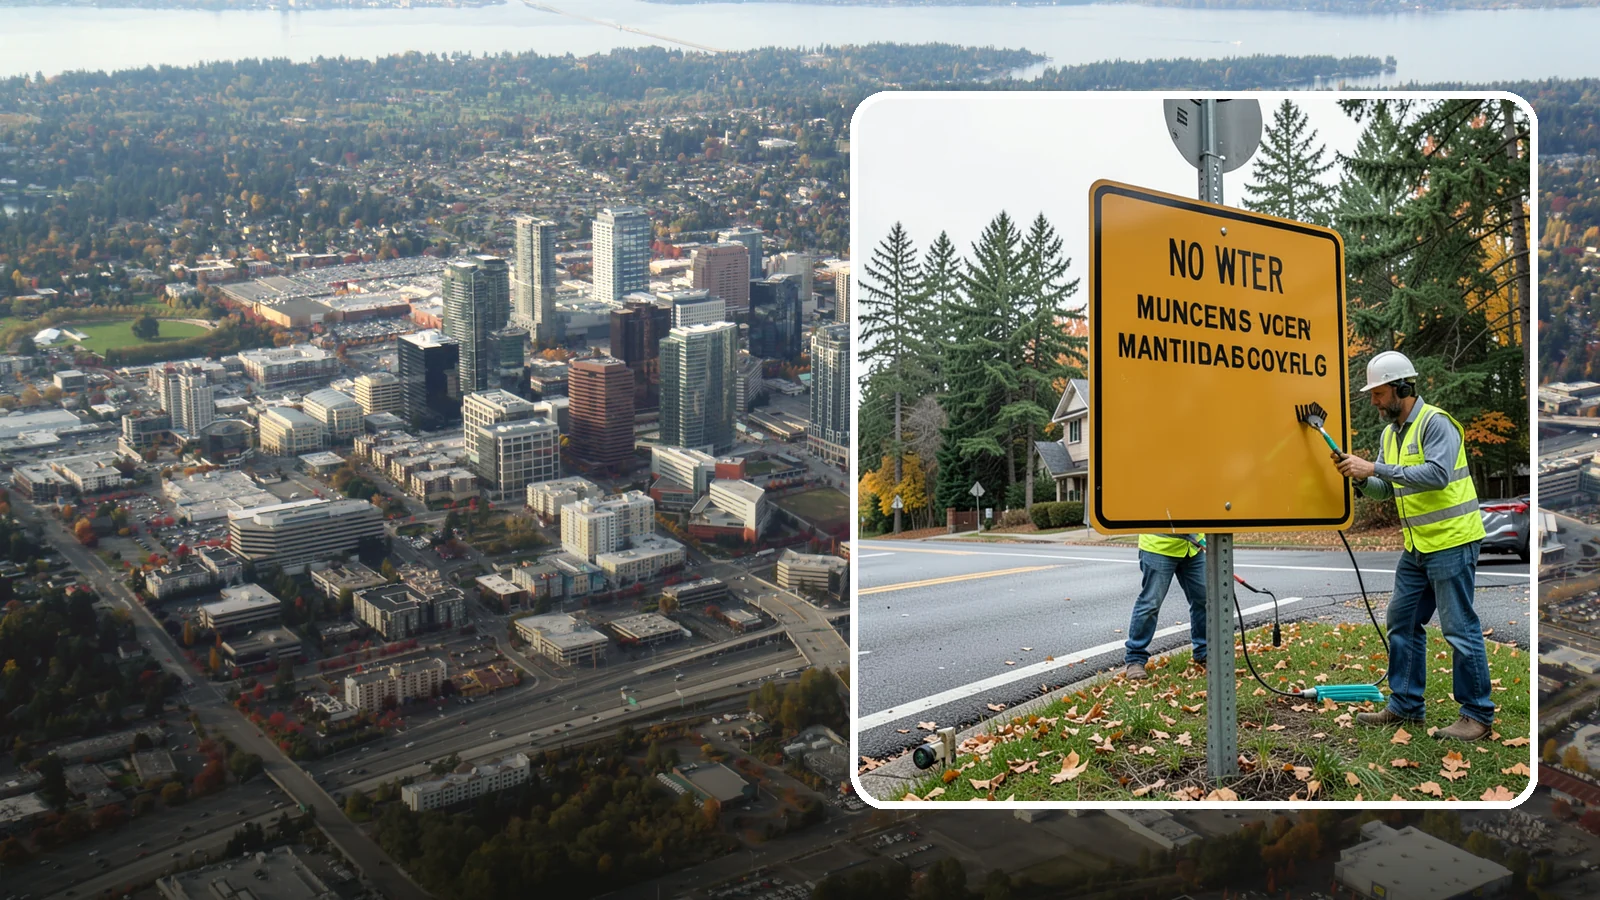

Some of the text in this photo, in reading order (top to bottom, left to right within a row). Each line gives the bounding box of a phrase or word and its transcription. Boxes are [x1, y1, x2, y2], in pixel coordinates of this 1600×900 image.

[1169, 237, 1284, 294] NO WTER
[1137, 293, 1252, 333] MUNCENS
